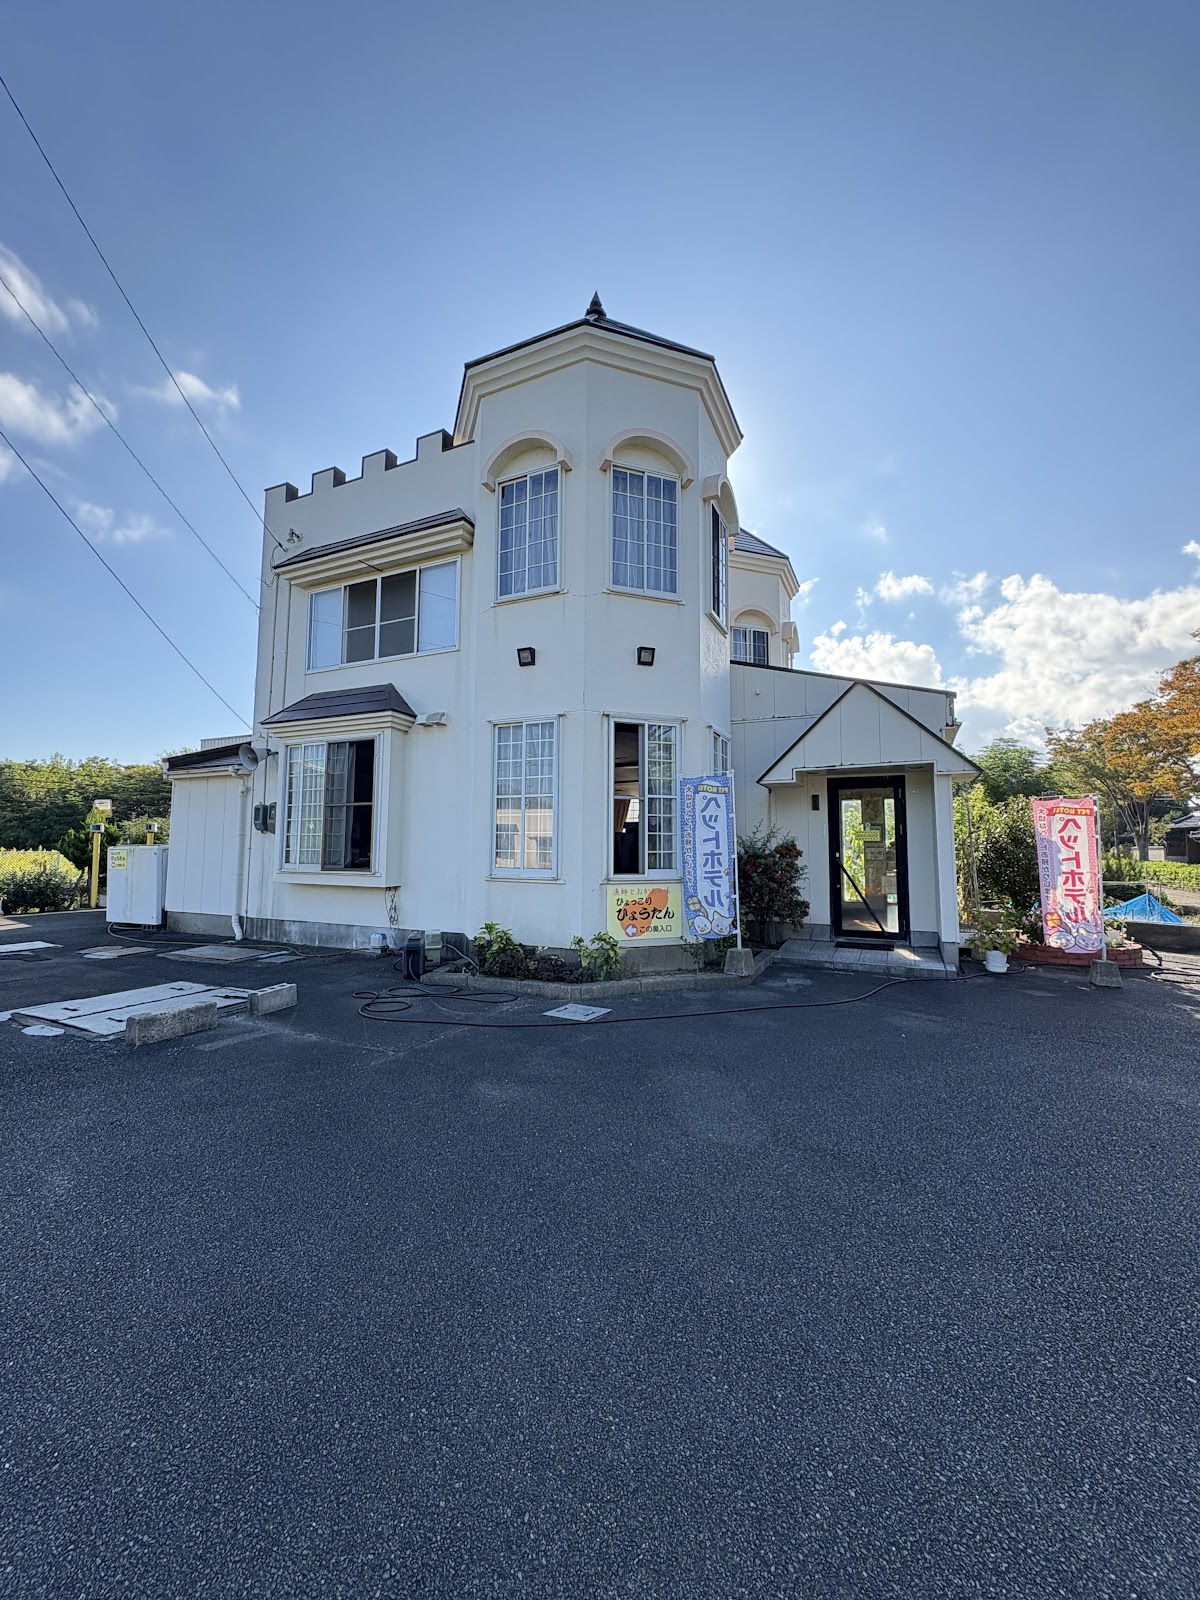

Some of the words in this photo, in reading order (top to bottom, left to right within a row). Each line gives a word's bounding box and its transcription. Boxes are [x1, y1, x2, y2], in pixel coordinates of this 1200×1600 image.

[616, 897, 652, 906] ひょっこり
[616, 907, 674, 921] ひょうたん
[640, 925, 672, 933] この奥入口
